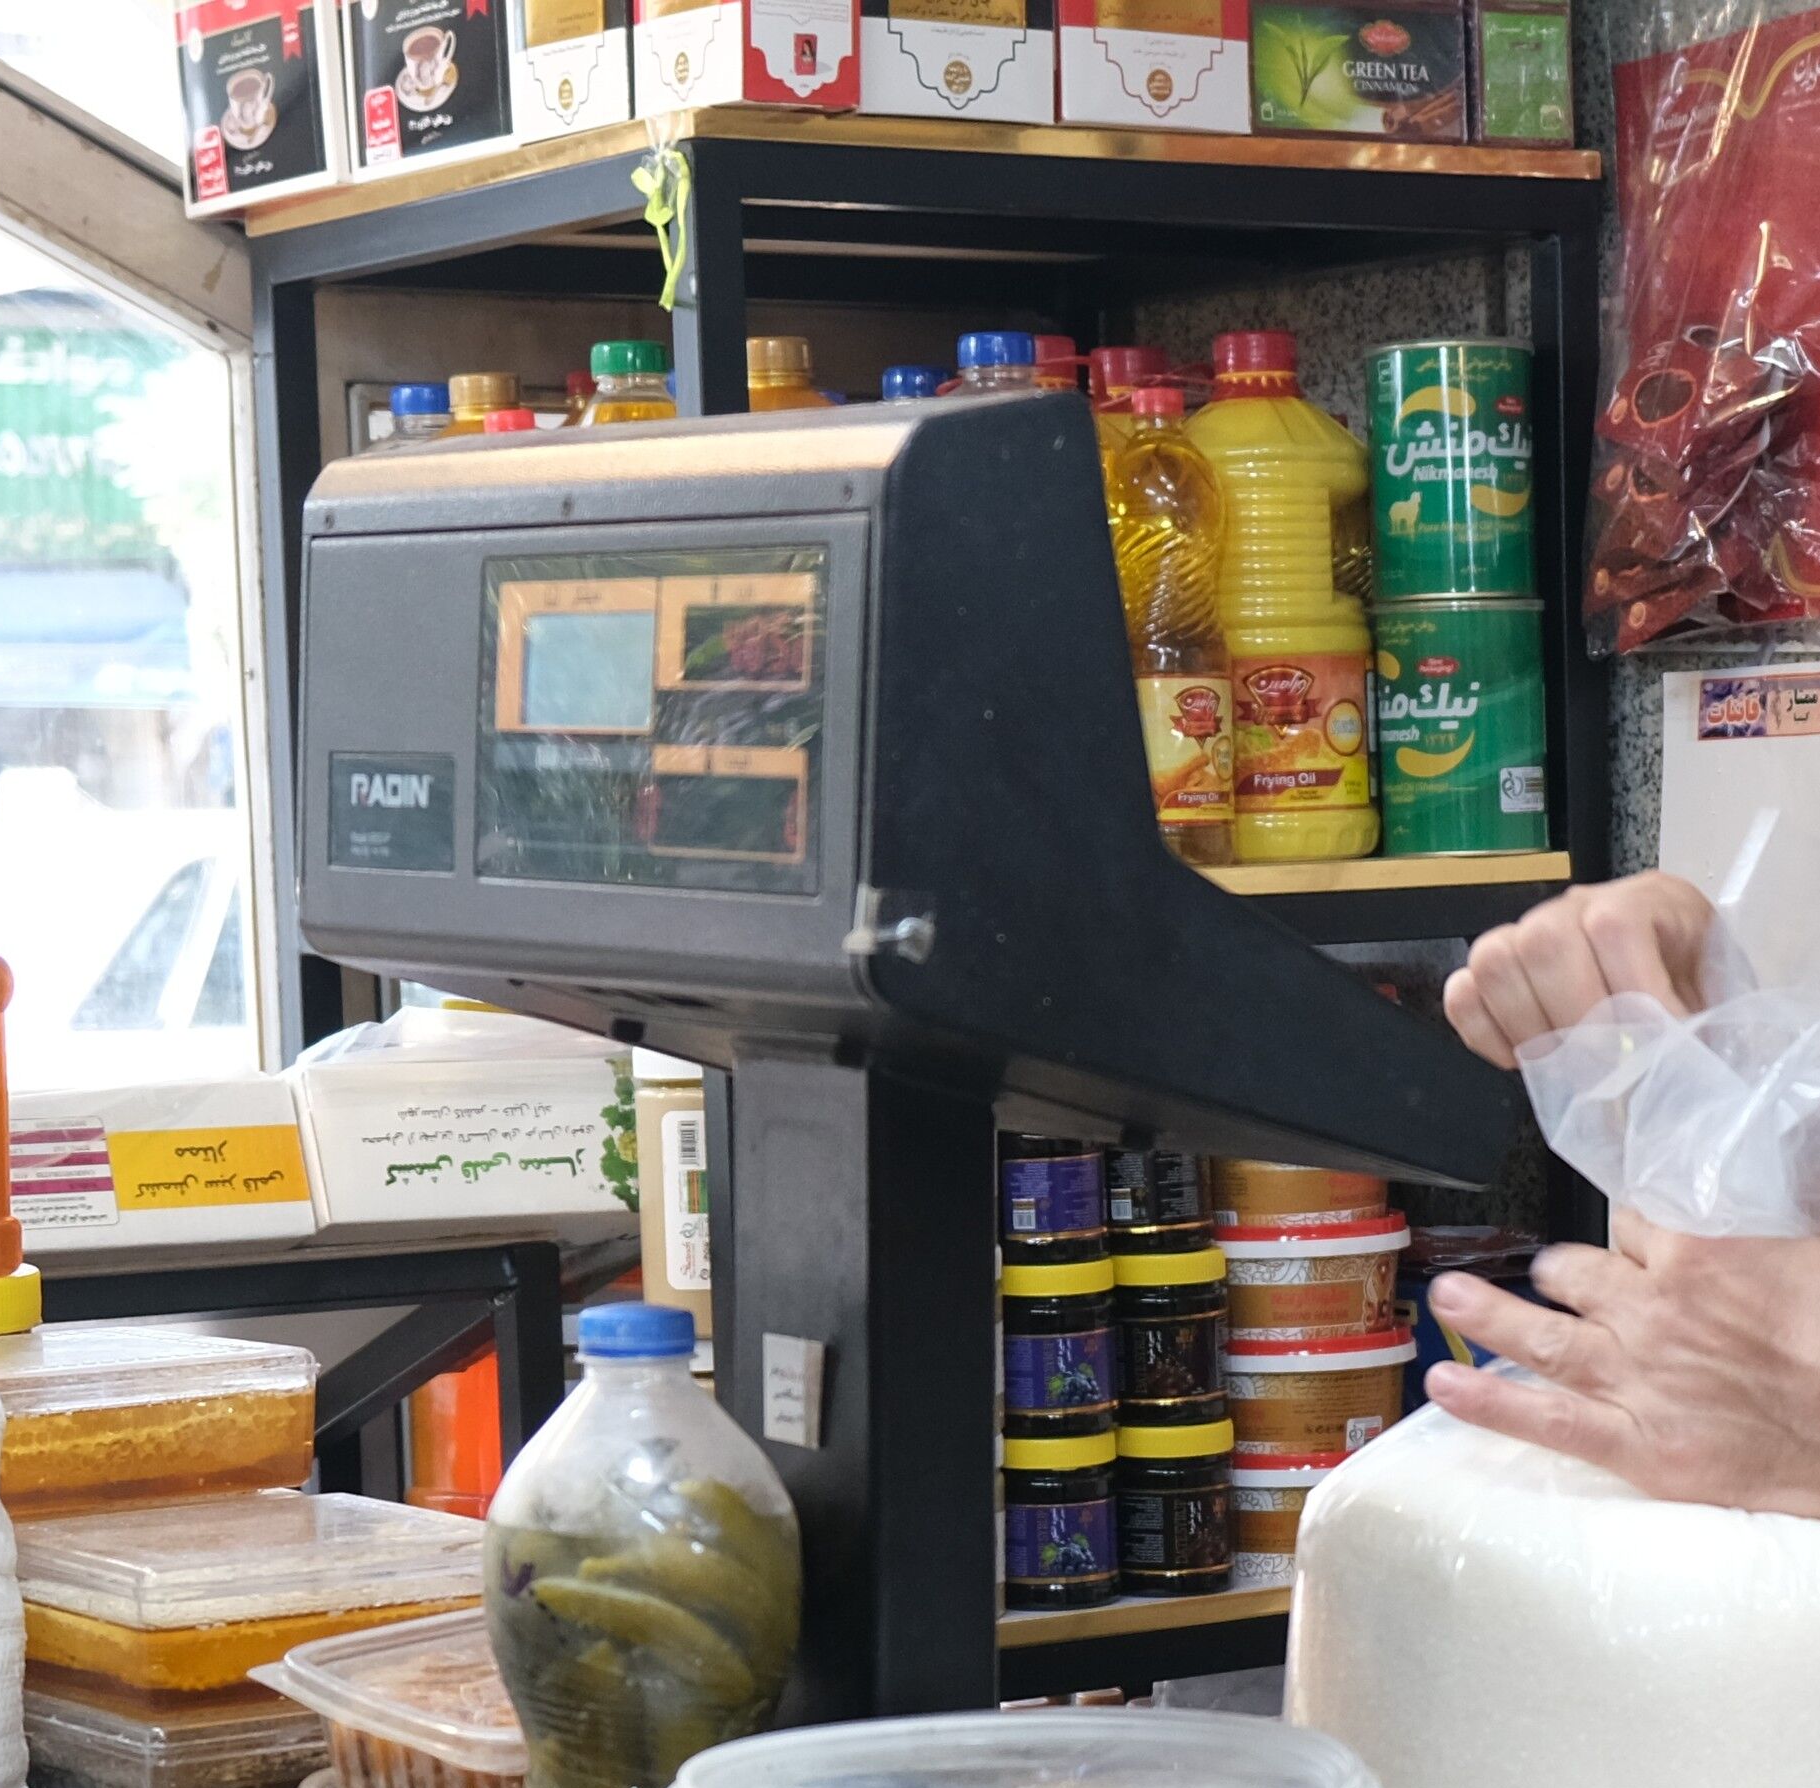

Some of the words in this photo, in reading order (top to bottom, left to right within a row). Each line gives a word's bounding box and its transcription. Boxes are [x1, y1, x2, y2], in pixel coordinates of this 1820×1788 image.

[1343, 60, 1399, 79] GREEN
[1402, 63, 1430, 82] TEA
[1353, 79, 1420, 94] CINNAMON
[1378, 685, 1411, 720] من
[1253, 773, 1296, 787] Frying
[1298, 773, 1316, 784] Oil
[1177, 791, 1208, 803] Frying
[172, 1138, 230, 1164] ممتاز
[383, 1151, 454, 1187] کشمش
[459, 1147, 513, 1184] قلمی
[517, 1145, 589, 1180] ممتاز
[131, 1176, 193, 1201] کشمش
[199, 1174, 238, 1195] سبز
[240, 1167, 286, 1193] قلمی
